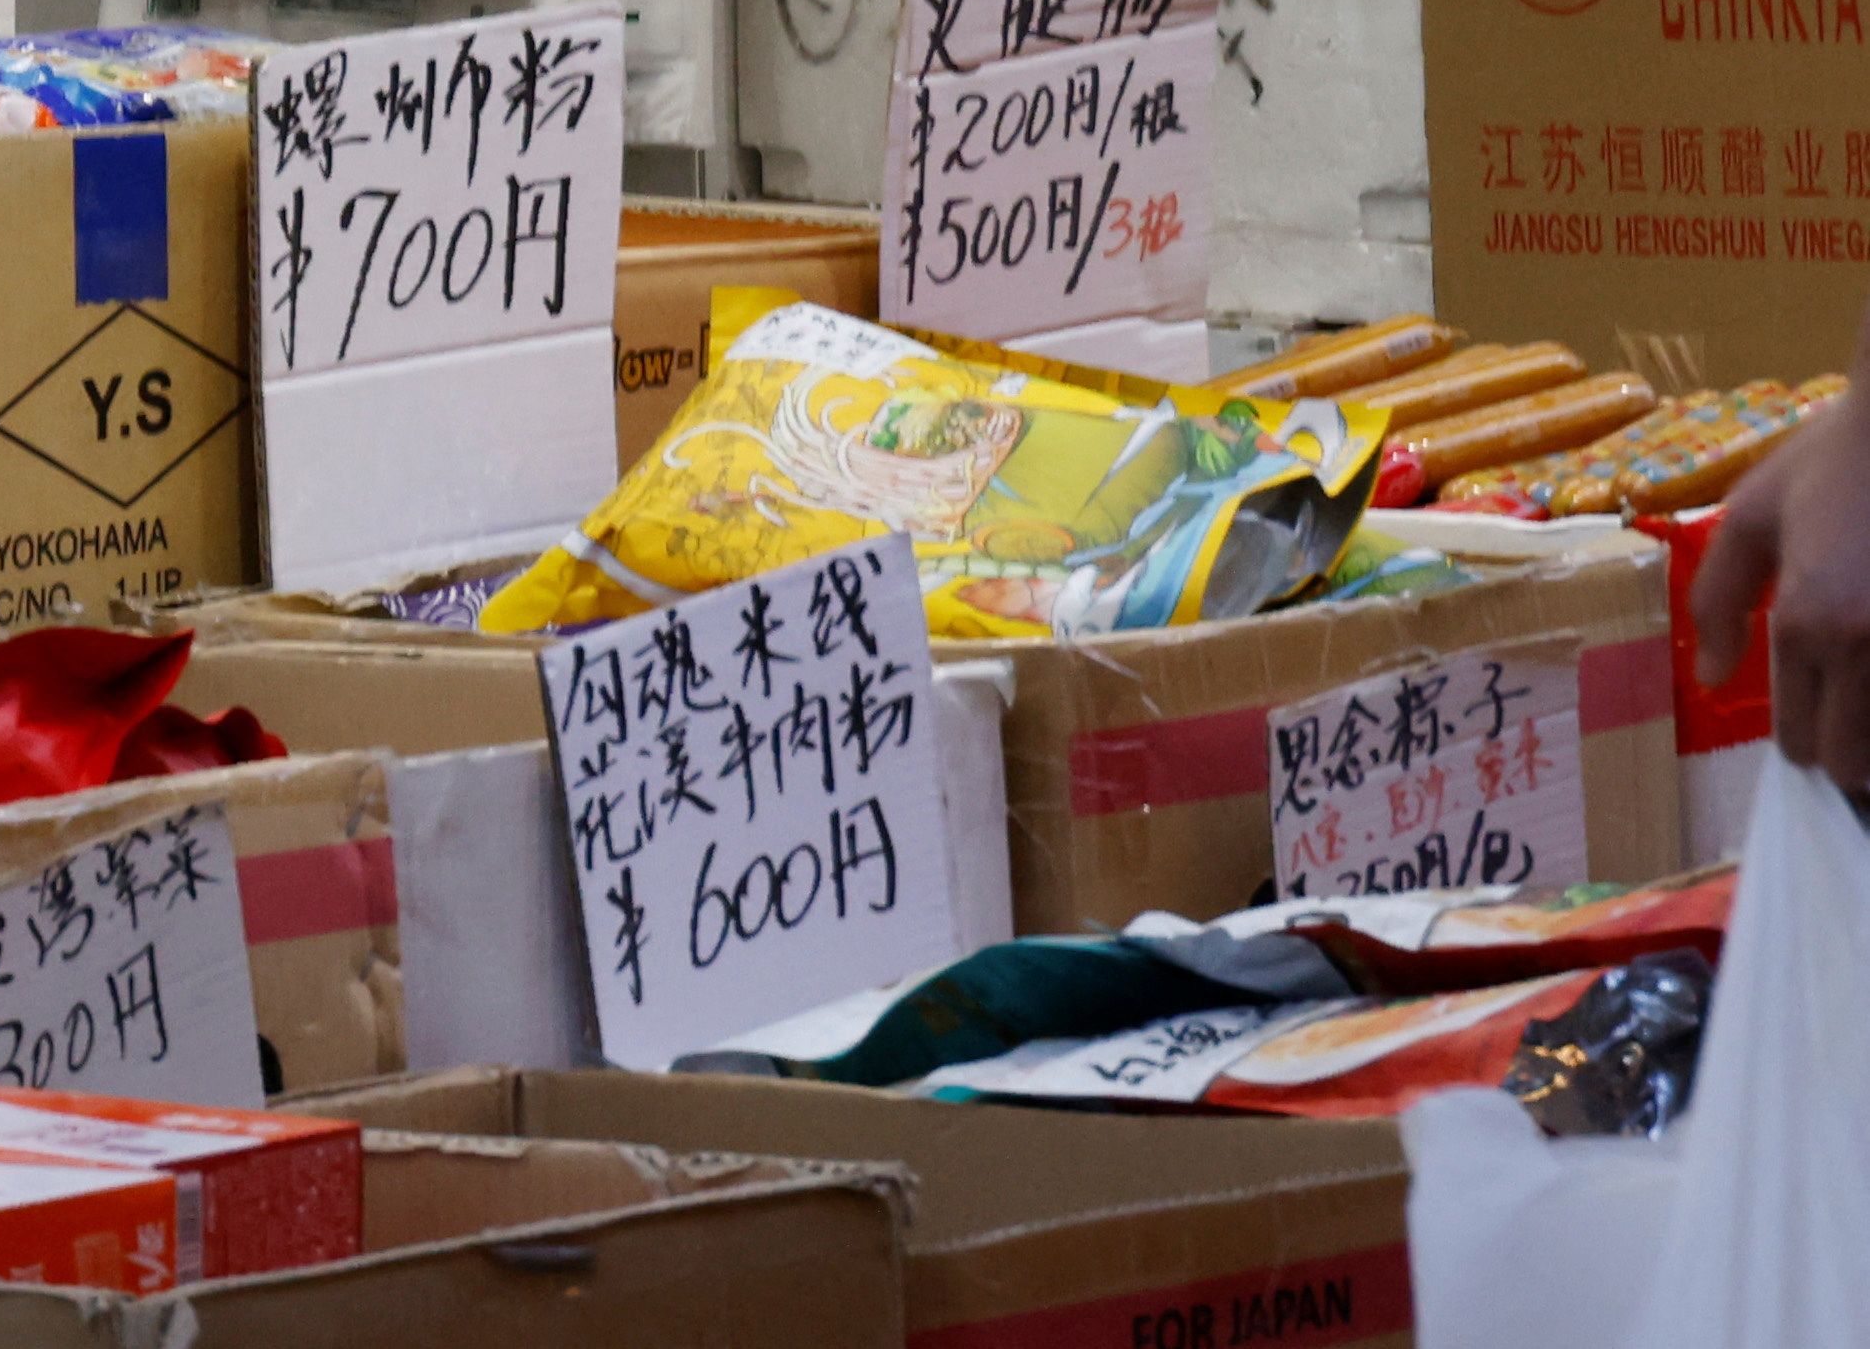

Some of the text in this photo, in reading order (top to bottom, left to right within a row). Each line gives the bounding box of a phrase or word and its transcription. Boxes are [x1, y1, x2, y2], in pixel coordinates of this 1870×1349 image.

[270, 175, 572, 370] ¥700円
[1485, 212, 1870, 262] JIANGSU HENGSHUN VINEG
[83, 370, 174, 441] Y.S
[606, 797, 898, 1007] ¥600円
[1131, 1275, 1354, 1349] FOR JAPAN
